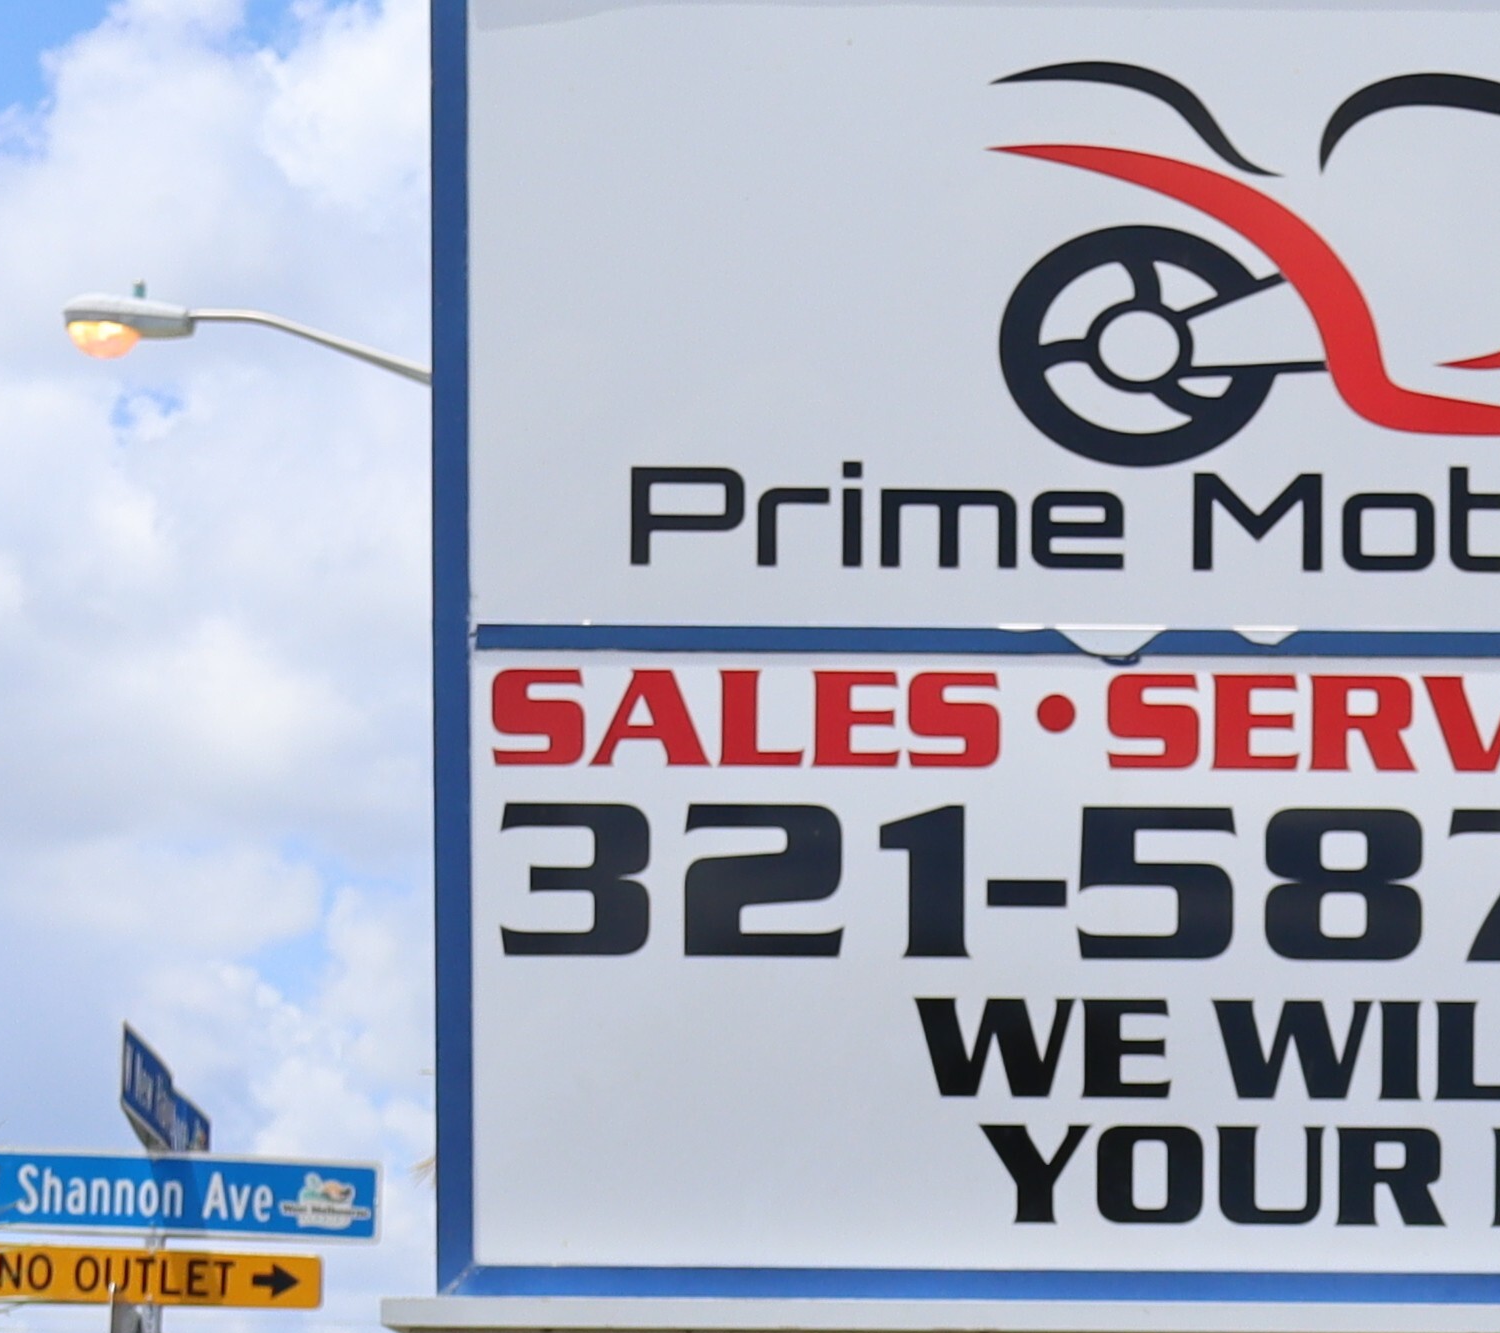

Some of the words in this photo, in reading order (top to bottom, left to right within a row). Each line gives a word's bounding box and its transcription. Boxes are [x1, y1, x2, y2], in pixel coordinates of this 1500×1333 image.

[631, 461, 1126, 570] Prime
[493, 669, 1000, 767] SALES
[915, 998, 1170, 1098] WE
[17, 1163, 184, 1219] Shannon
[202, 1171, 274, 1223] Ave
[980, 1125, 1444, 1225] YOUR
[74, 1255, 235, 1297] OUTLET
